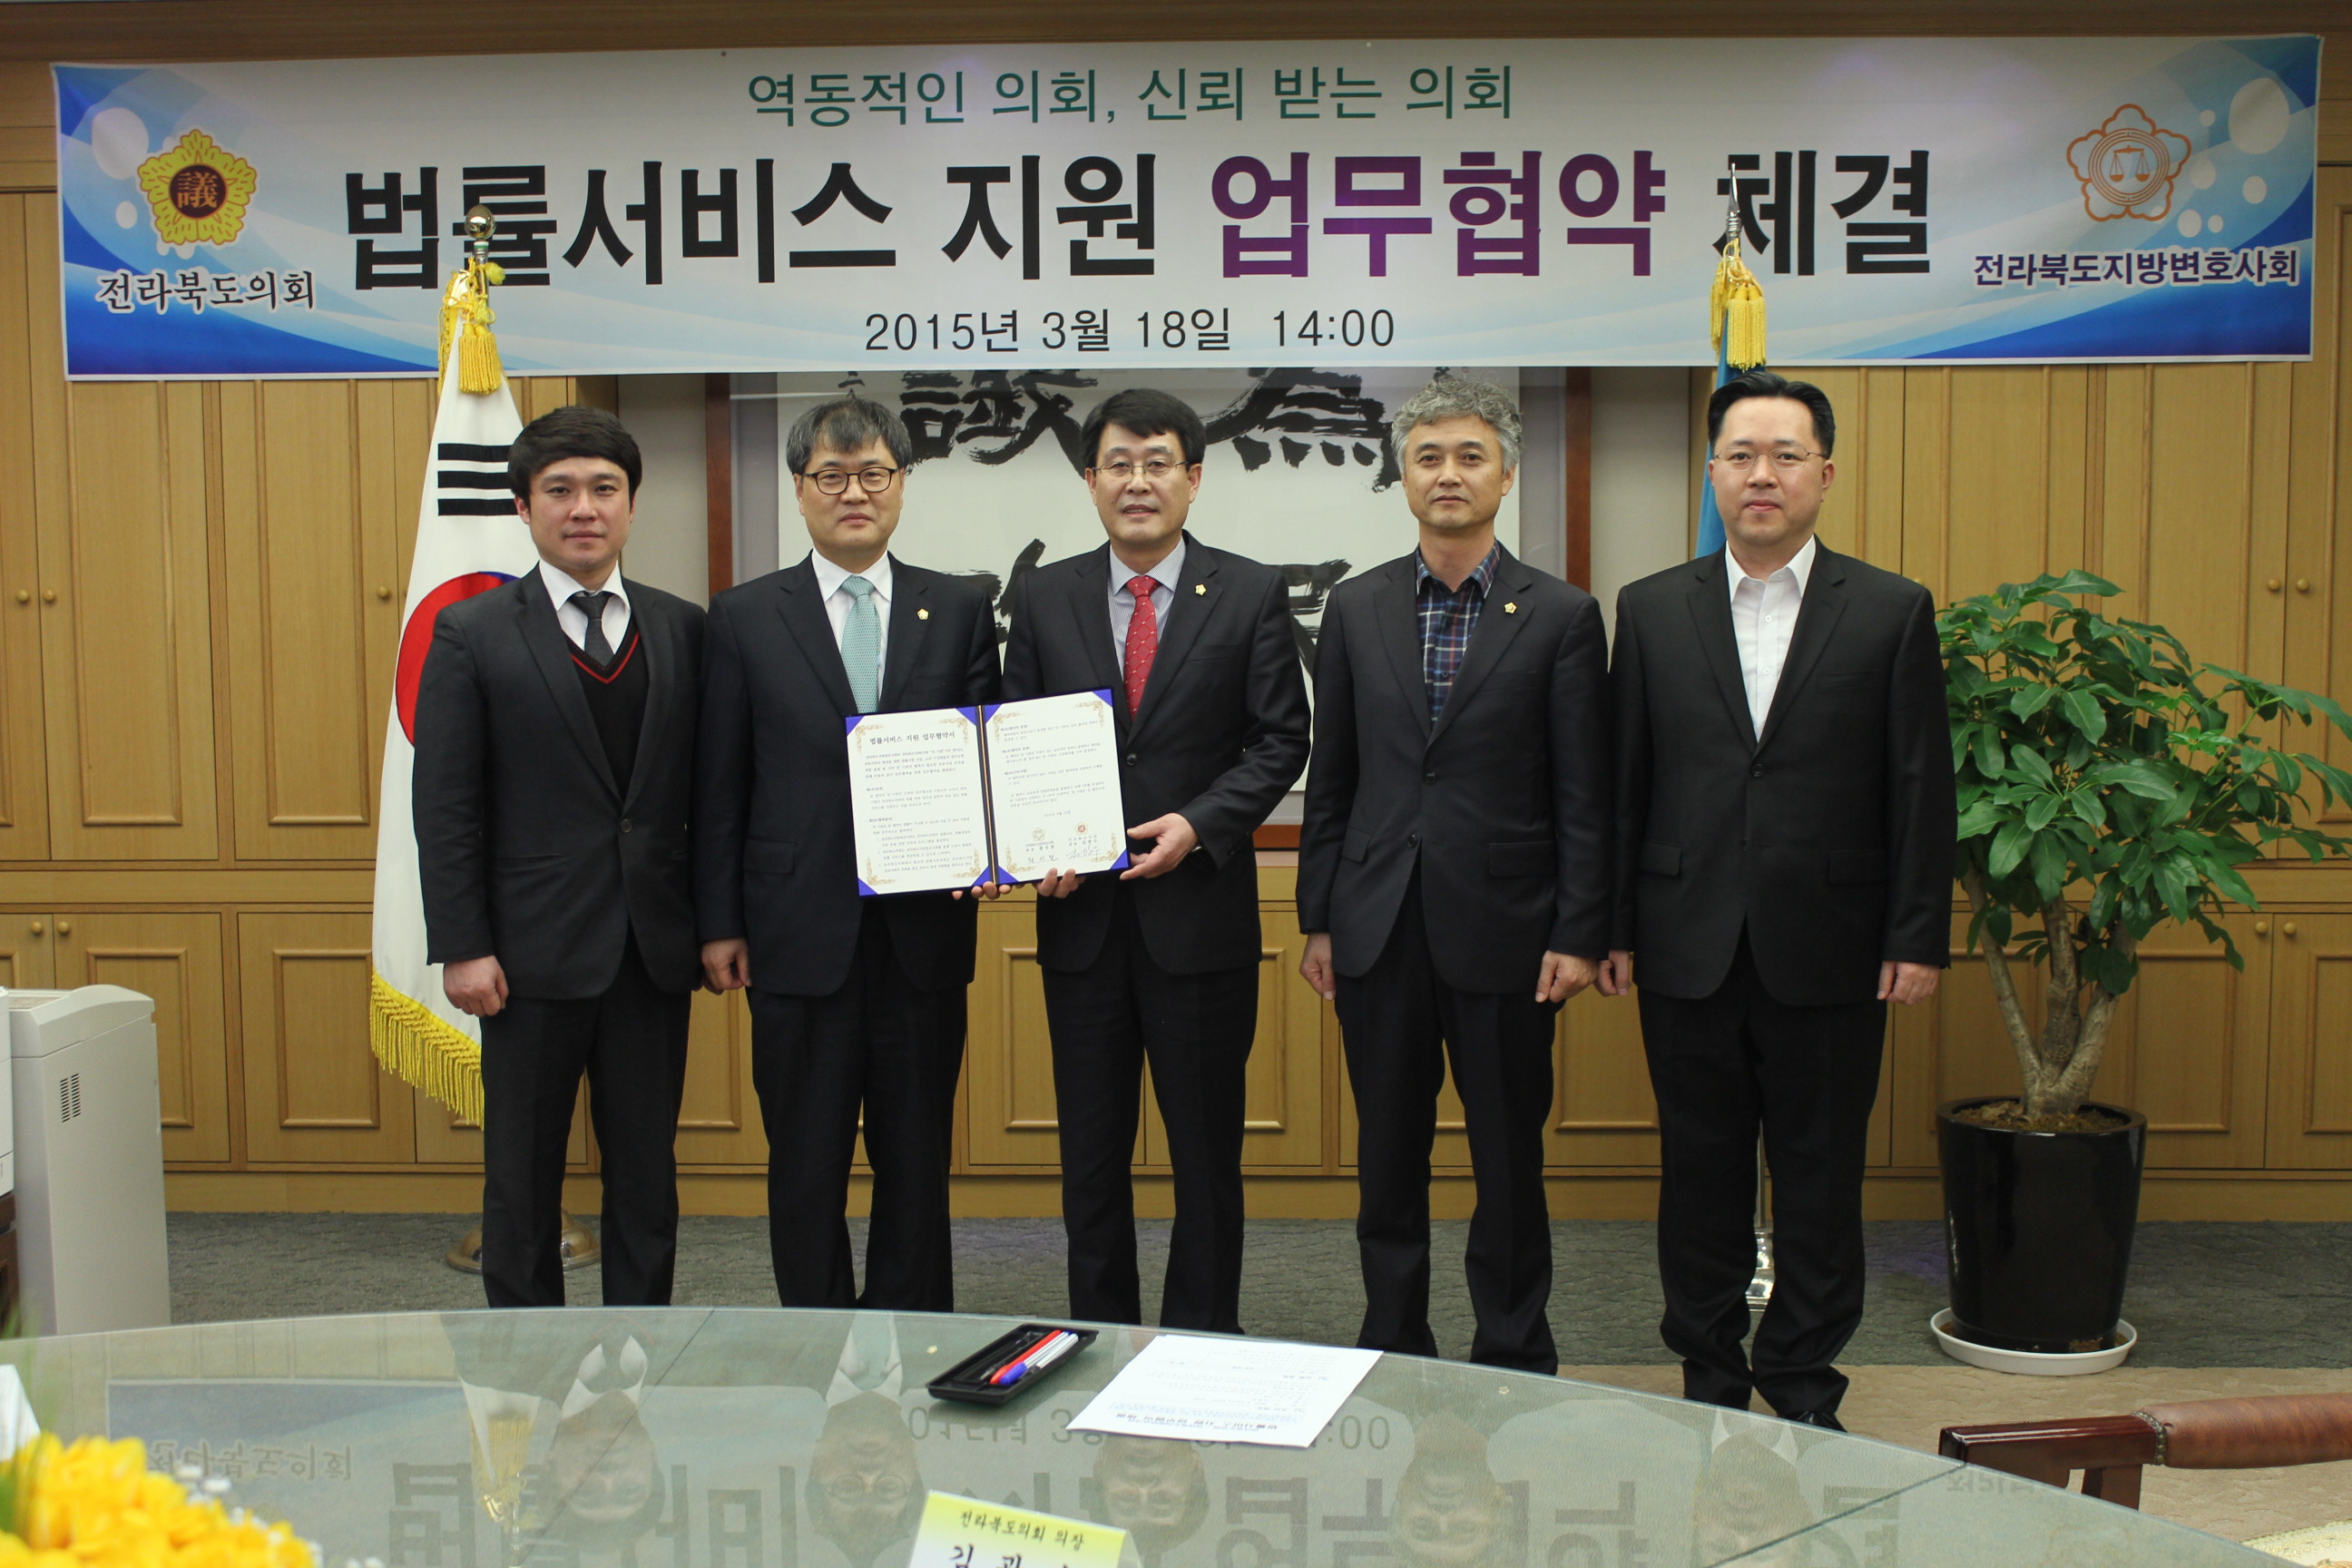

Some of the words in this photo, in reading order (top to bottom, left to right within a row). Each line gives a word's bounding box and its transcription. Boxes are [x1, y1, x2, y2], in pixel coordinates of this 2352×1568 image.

[749, 71, 965, 127] 역동적인
[993, 69, 1115, 123] 의회,
[1137, 67, 1244, 121] 신뢰
[1274, 65, 1383, 120] 받는
[1408, 64, 1513, 120] 의회
[345, 159, 897, 290] 법률서비스
[941, 153, 1156, 280] 지원
[1211, 150, 1666, 279] 업무협약
[1712, 150, 1930, 276] 체결
[1974, 250, 2298, 287] 전라북도지방변호사회
[99, 270, 314, 311] 전라북도의회
[866, 309, 1019, 352] 2015년
[1042, 309, 1110, 352] 3월
[1137, 308, 1230, 351] 18일
[1273, 309, 1394, 348] 14:00
[869, 736, 904, 745] 법률서비스
[906, 733, 919, 741] 지원
[922, 731, 956, 741] 업무협약서
[960, 1510, 1046, 1542] 전라북도의회
[1054, 1530, 1084, 1551] 의장
